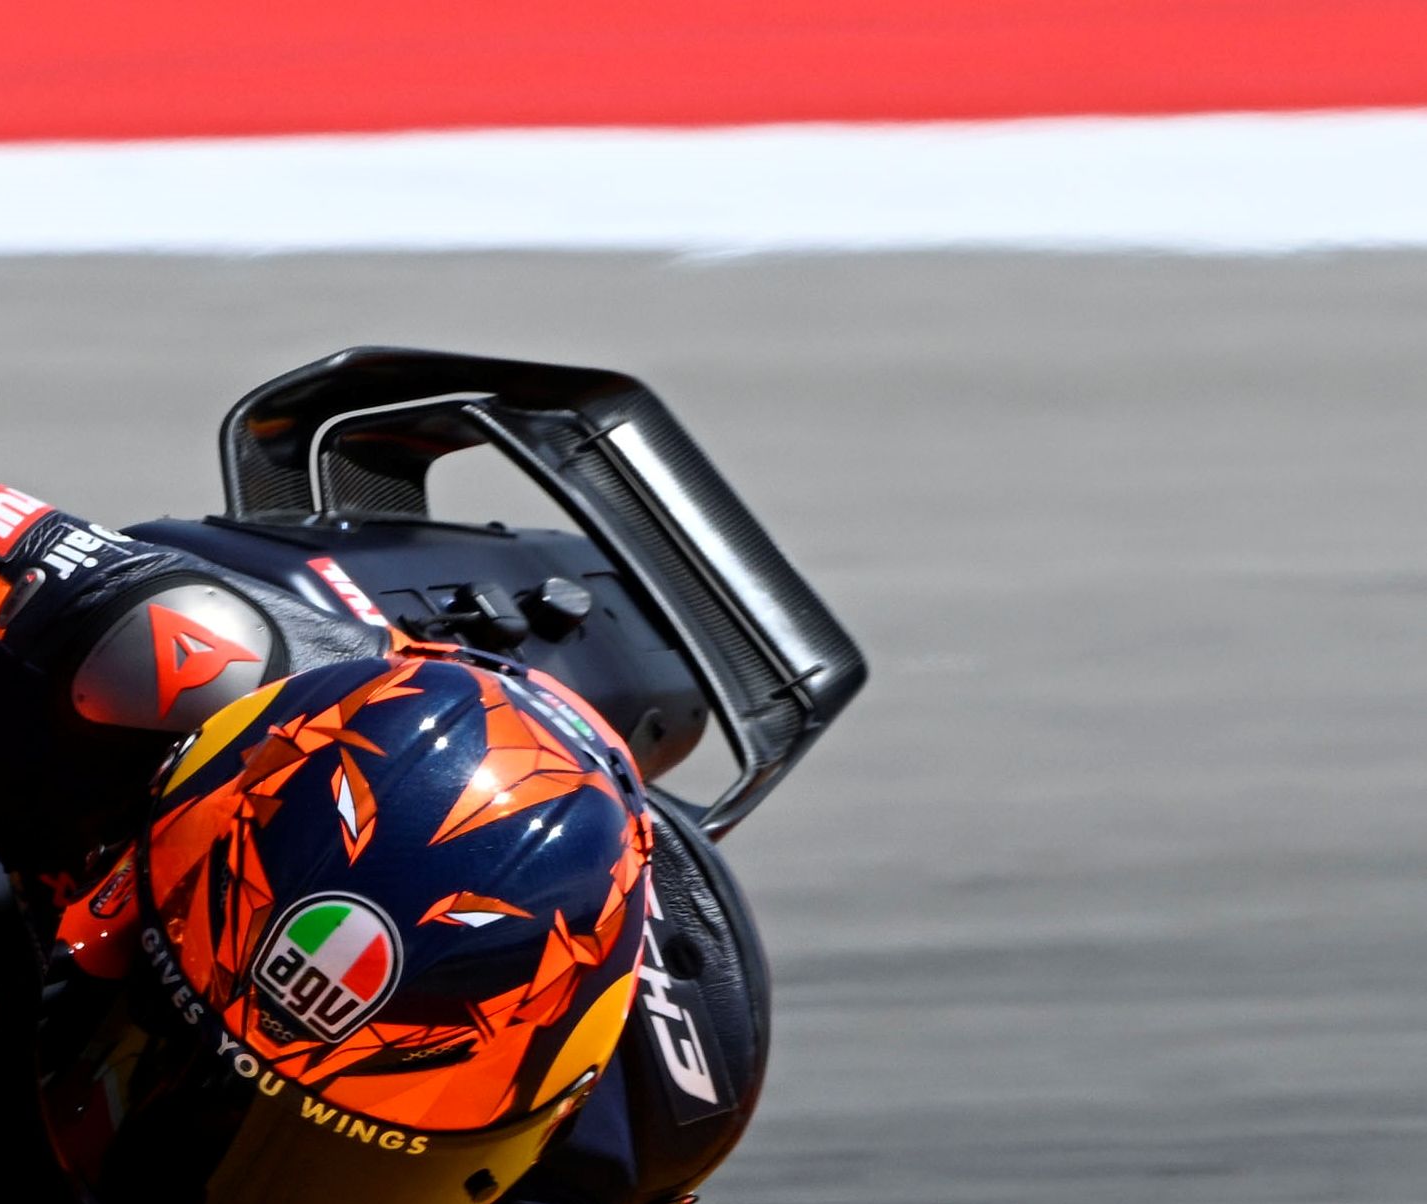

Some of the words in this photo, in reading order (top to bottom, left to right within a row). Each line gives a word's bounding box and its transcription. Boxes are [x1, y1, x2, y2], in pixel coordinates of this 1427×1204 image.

[141, 927, 202, 1027] GIVES
[215, 1030, 287, 1099] YOU
[299, 1095, 430, 1156] WINGS
[266, 947, 360, 1026] agv
